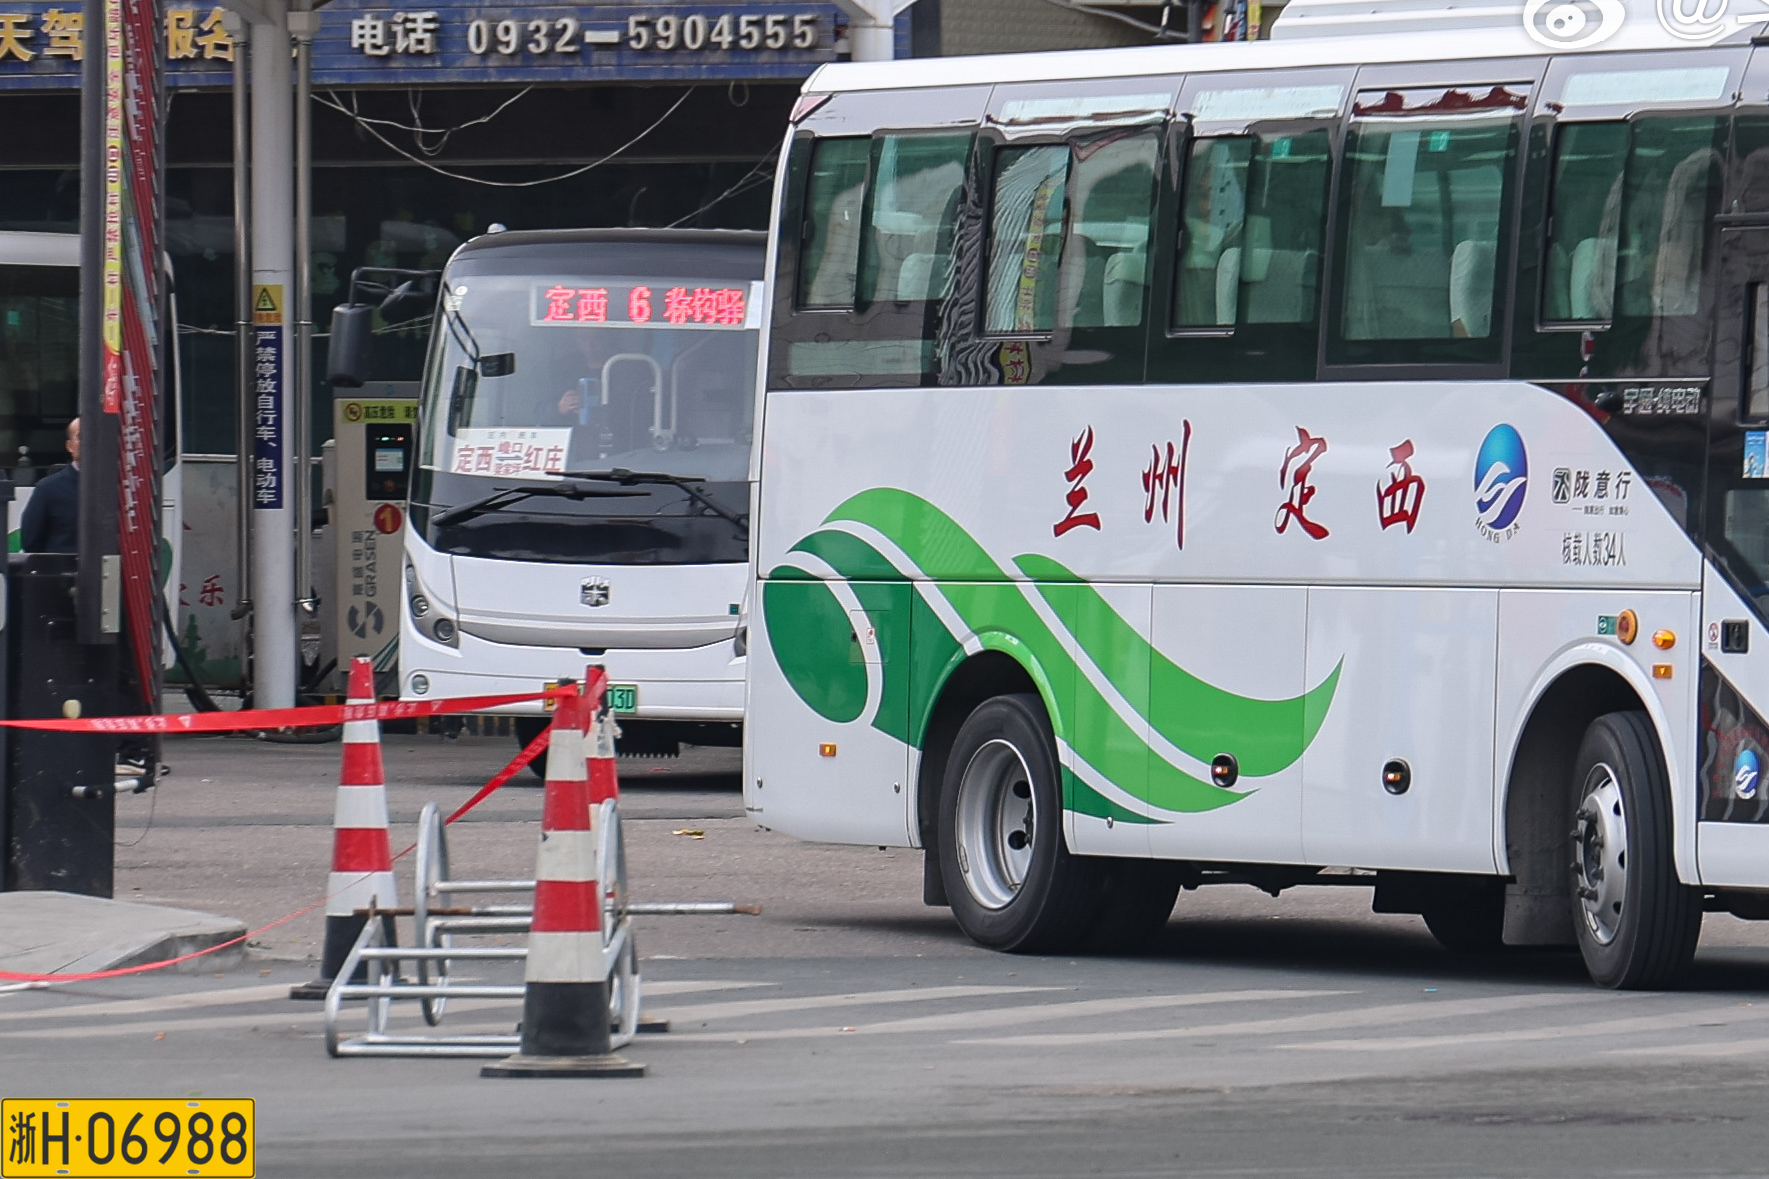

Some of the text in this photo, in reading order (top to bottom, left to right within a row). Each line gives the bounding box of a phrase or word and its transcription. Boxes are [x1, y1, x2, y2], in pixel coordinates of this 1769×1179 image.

[350, 12, 438, 56] 电话
[543, 285, 608, 323] 定西
[629, 286, 651, 323] 6
[255, 330, 277, 504] 严禁停放自行车、电动车
[455, 444, 495, 472] 定西
[522, 445, 564, 472] 红庄
[1053, 419, 1426, 551] 兰州 定西
[1573, 470, 1632, 500] 陇意行
[379, 508, 393, 533] 1
[1475, 516, 1521, 544] HONG DA
[365, 529, 377, 598] GRASEN
[1562, 531, 1627, 566] 核载人数34人
